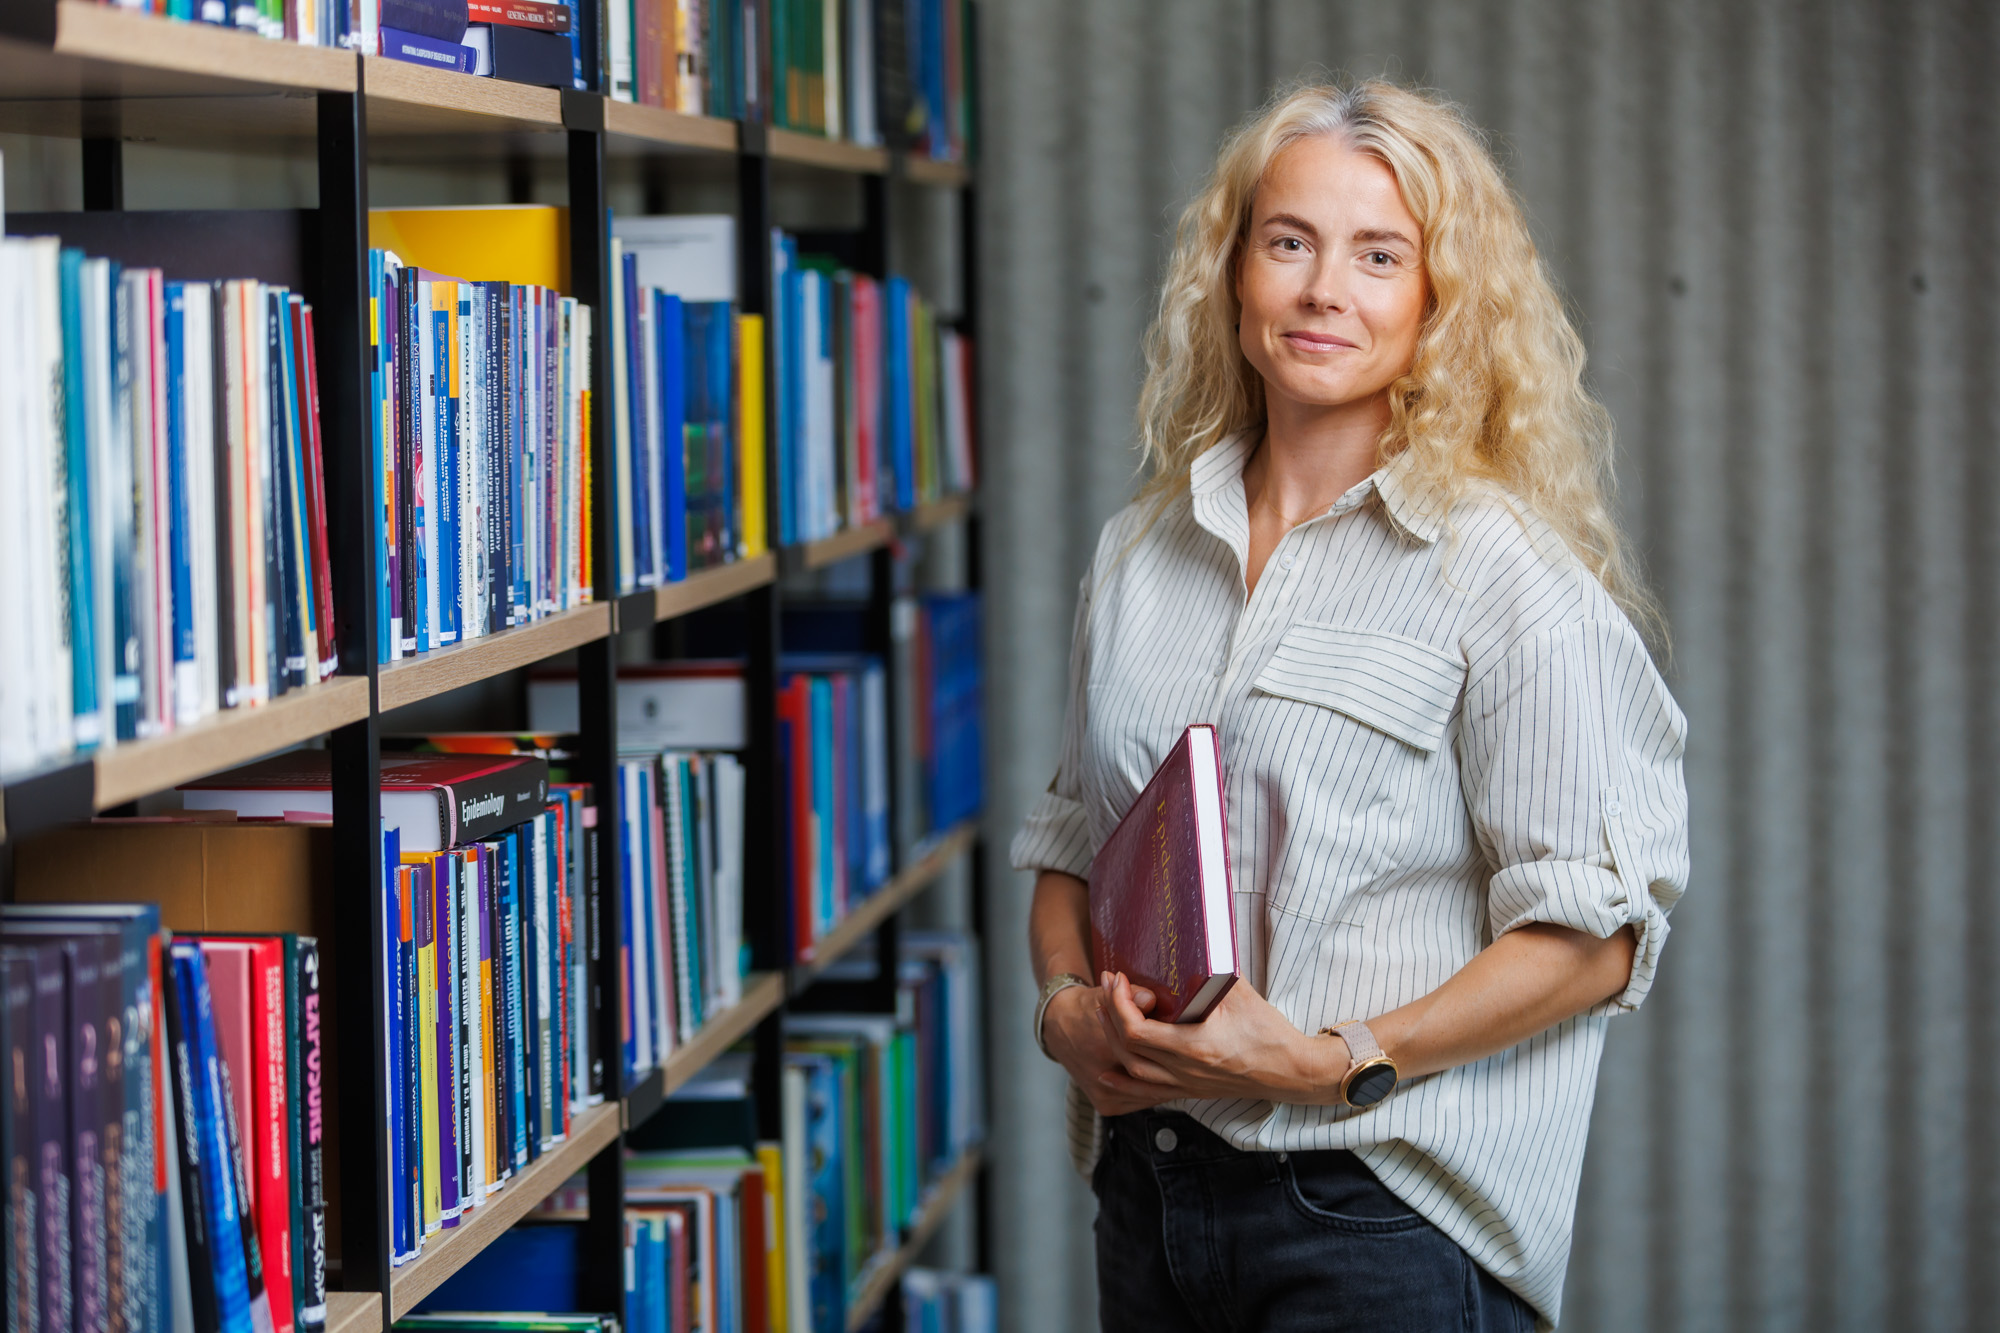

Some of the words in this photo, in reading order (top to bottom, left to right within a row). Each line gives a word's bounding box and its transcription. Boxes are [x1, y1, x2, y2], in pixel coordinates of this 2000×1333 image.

[506, 10, 525, 20] GENETICS
[528, 12, 544, 23] MEDICINE
[492, 356, 498, 368] of
[414, 342, 422, 454] Microenvironment
[462, 792, 505, 827] Epidemiology
[461, 871, 465, 884] IN
[1151, 834, 1160, 898] Principles
[1180, 768, 1192, 856] SECOND
[1191, 876, 1202, 976] EDITION
[1157, 799, 1180, 997] Epidemiology
[448, 992, 452, 1014] OF
[306, 994, 322, 1144] EXPOSURE
[462, 1073, 469, 1084] by
[543, 1030, 552, 1110] EPIDEMIOLOGY
